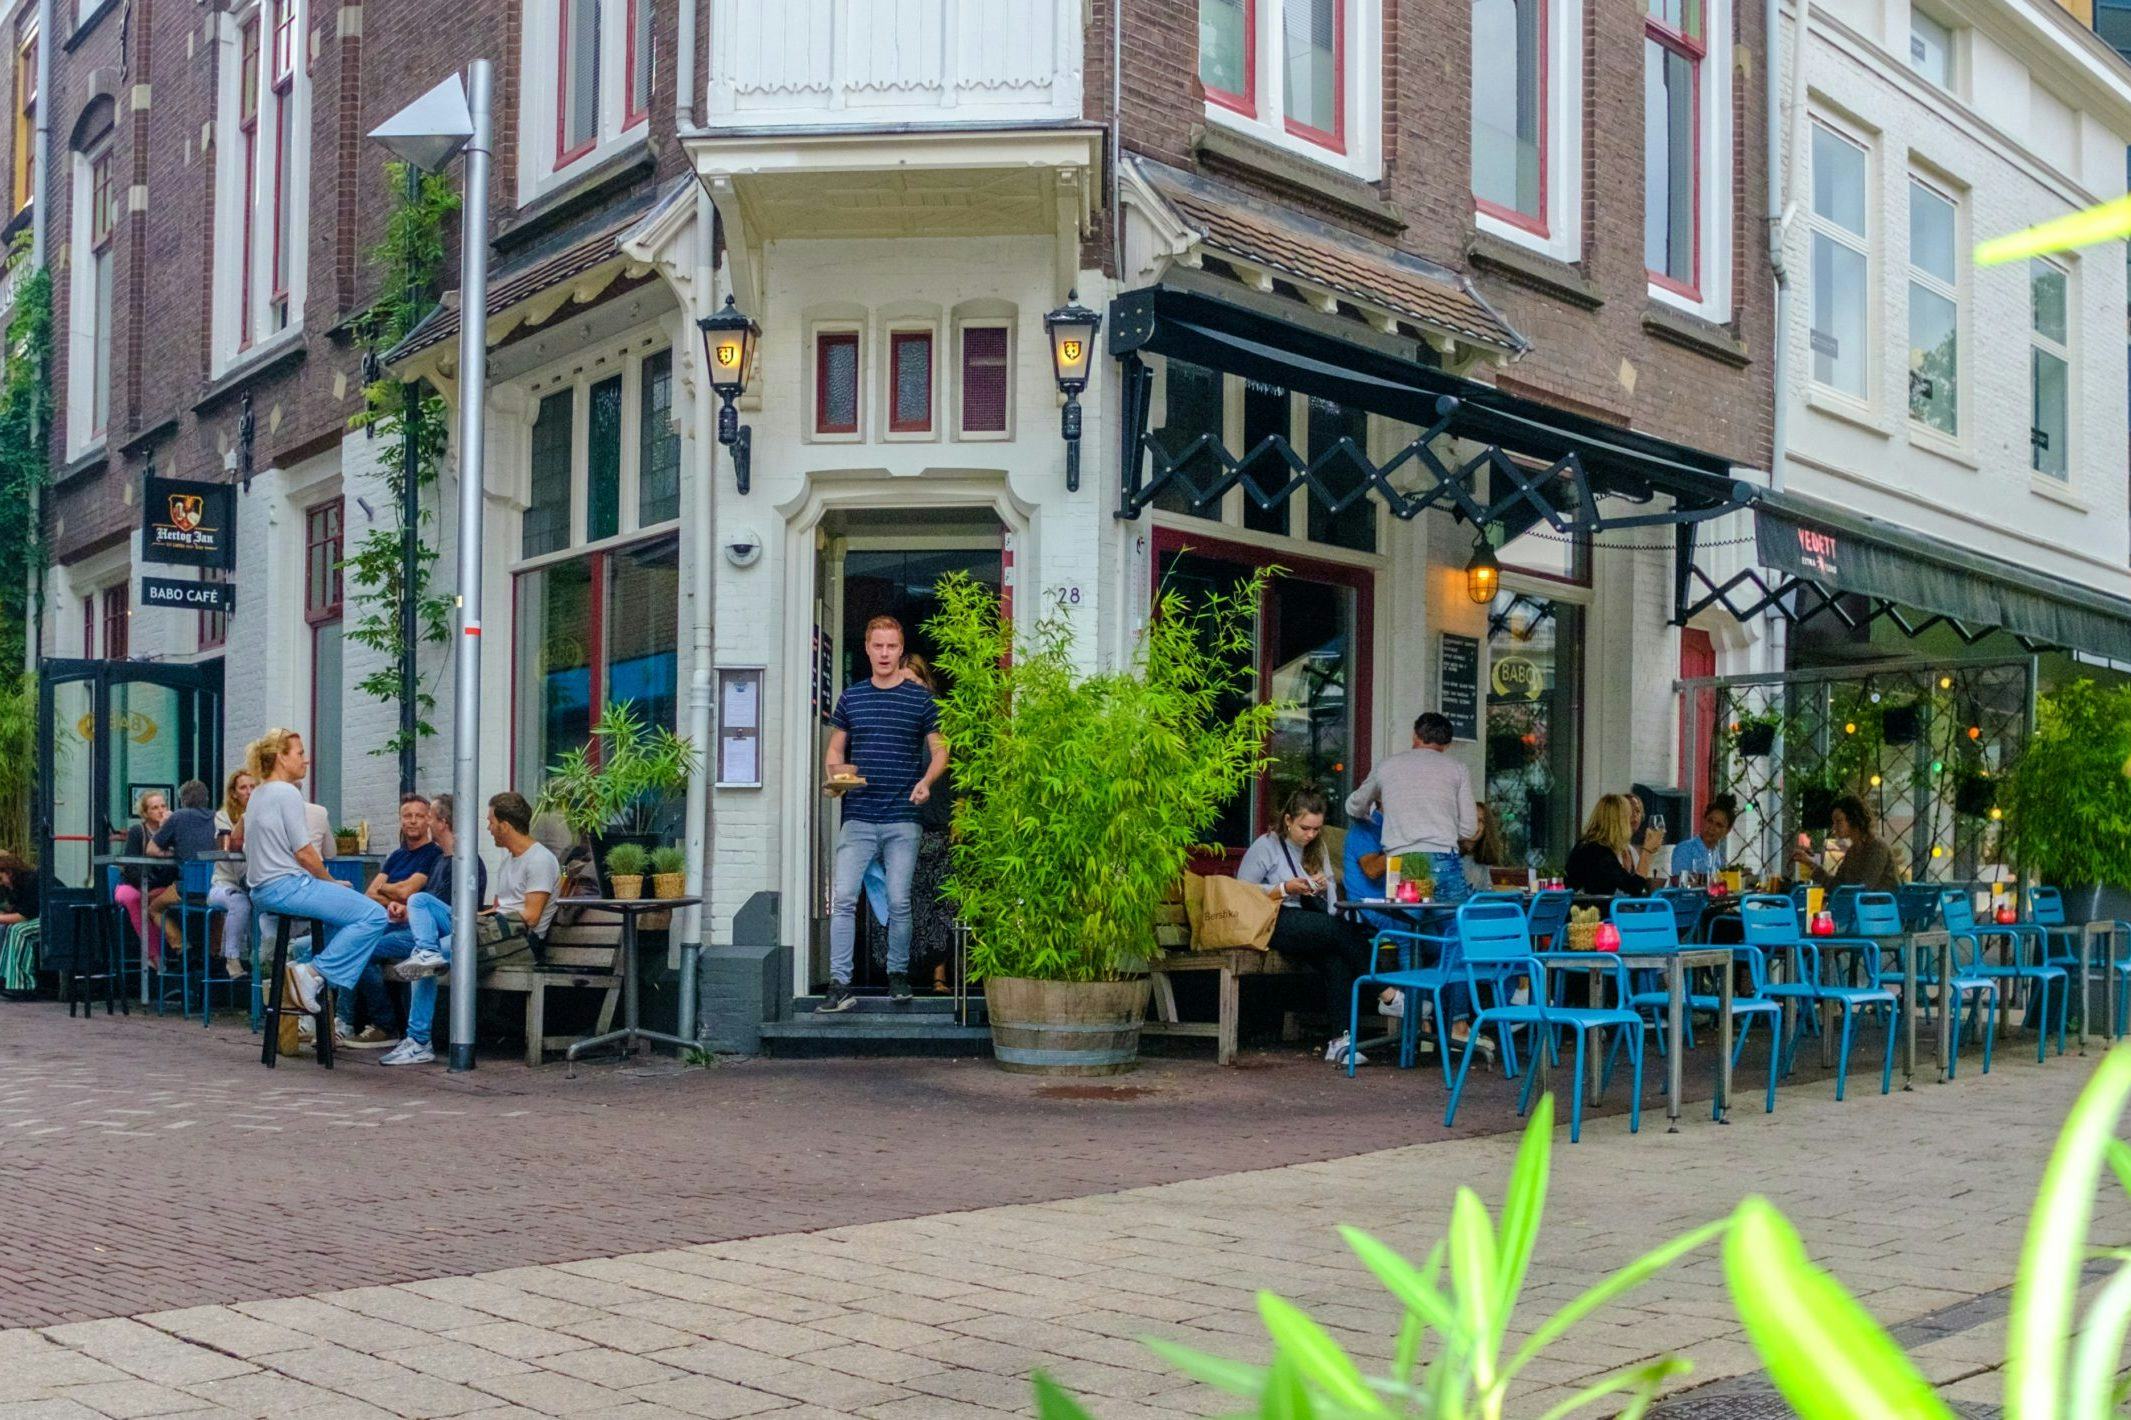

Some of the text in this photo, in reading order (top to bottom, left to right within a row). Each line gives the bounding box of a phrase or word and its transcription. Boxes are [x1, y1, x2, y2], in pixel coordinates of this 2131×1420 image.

[156, 527, 192, 543] Hertog
[194, 531, 214, 548] Jan
[1798, 528, 1836, 559] VEDETT
[150, 586, 218, 604] BABO CAFÉ
[1059, 587, 1080, 604] 28
[1501, 663, 1534, 684] BABO
